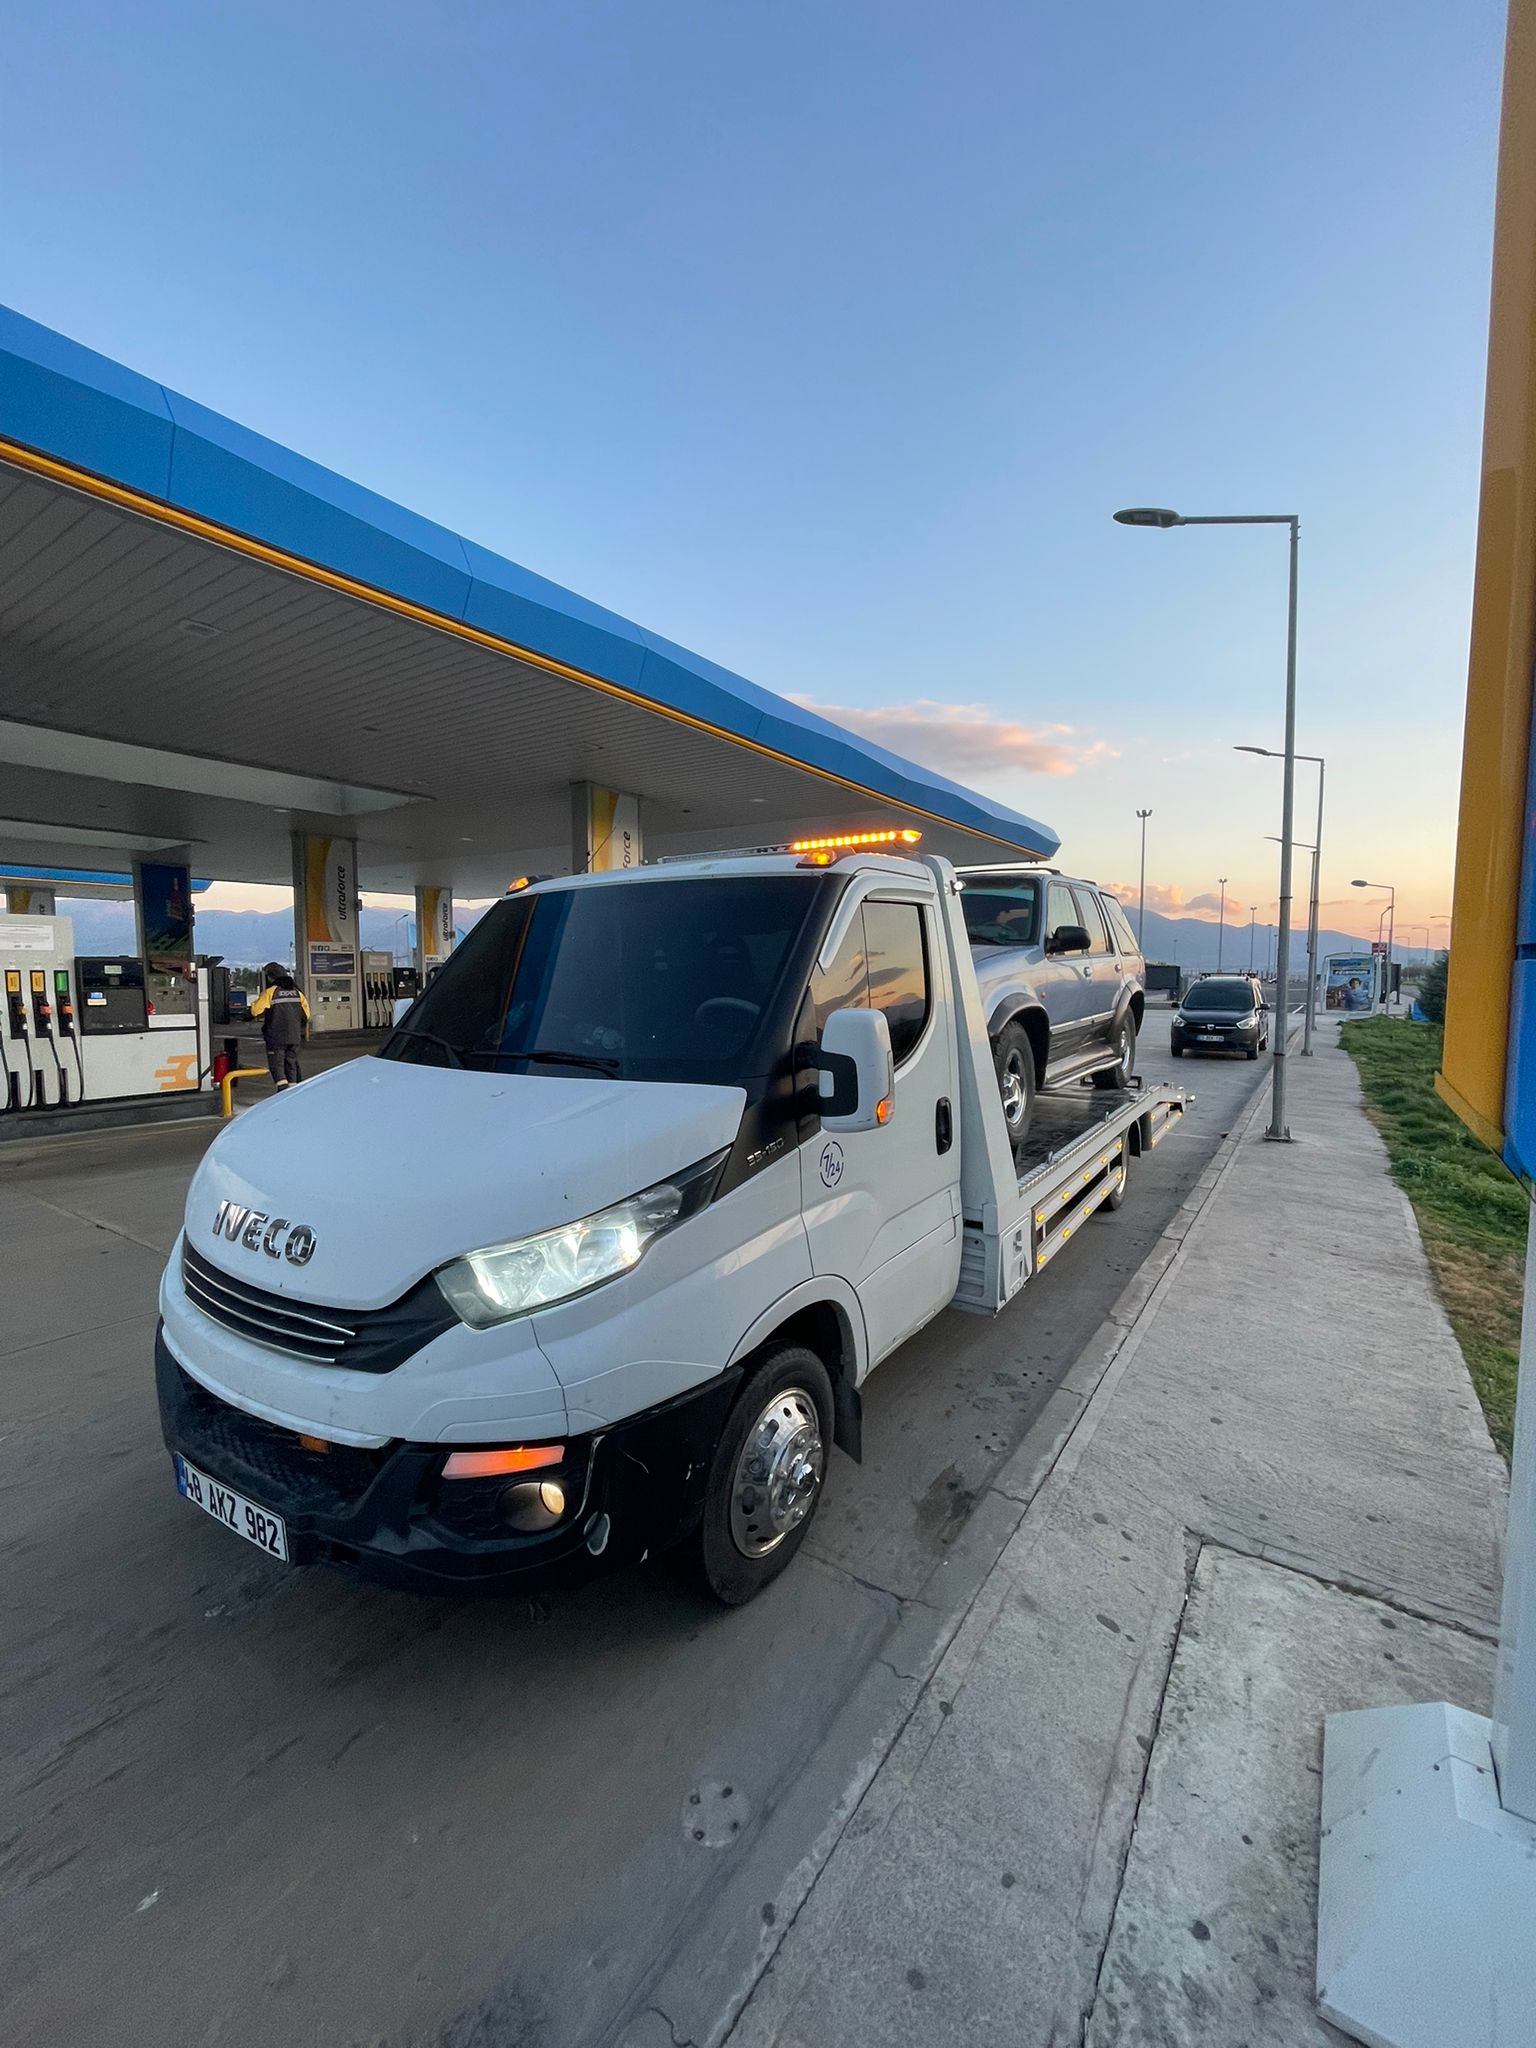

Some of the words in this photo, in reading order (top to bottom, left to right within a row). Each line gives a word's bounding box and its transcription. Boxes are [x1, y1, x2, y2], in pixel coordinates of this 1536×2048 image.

[337, 865, 347, 920] ultraforce
[746, 1137, 785, 1167] 35-150
[823, 1152, 841, 1179] 7/24
[212, 1199, 318, 1267] IVECO
[185, 1465, 203, 1504] 48
[209, 1482, 239, 1530] AKZ
[245, 1505, 281, 1555] 982
